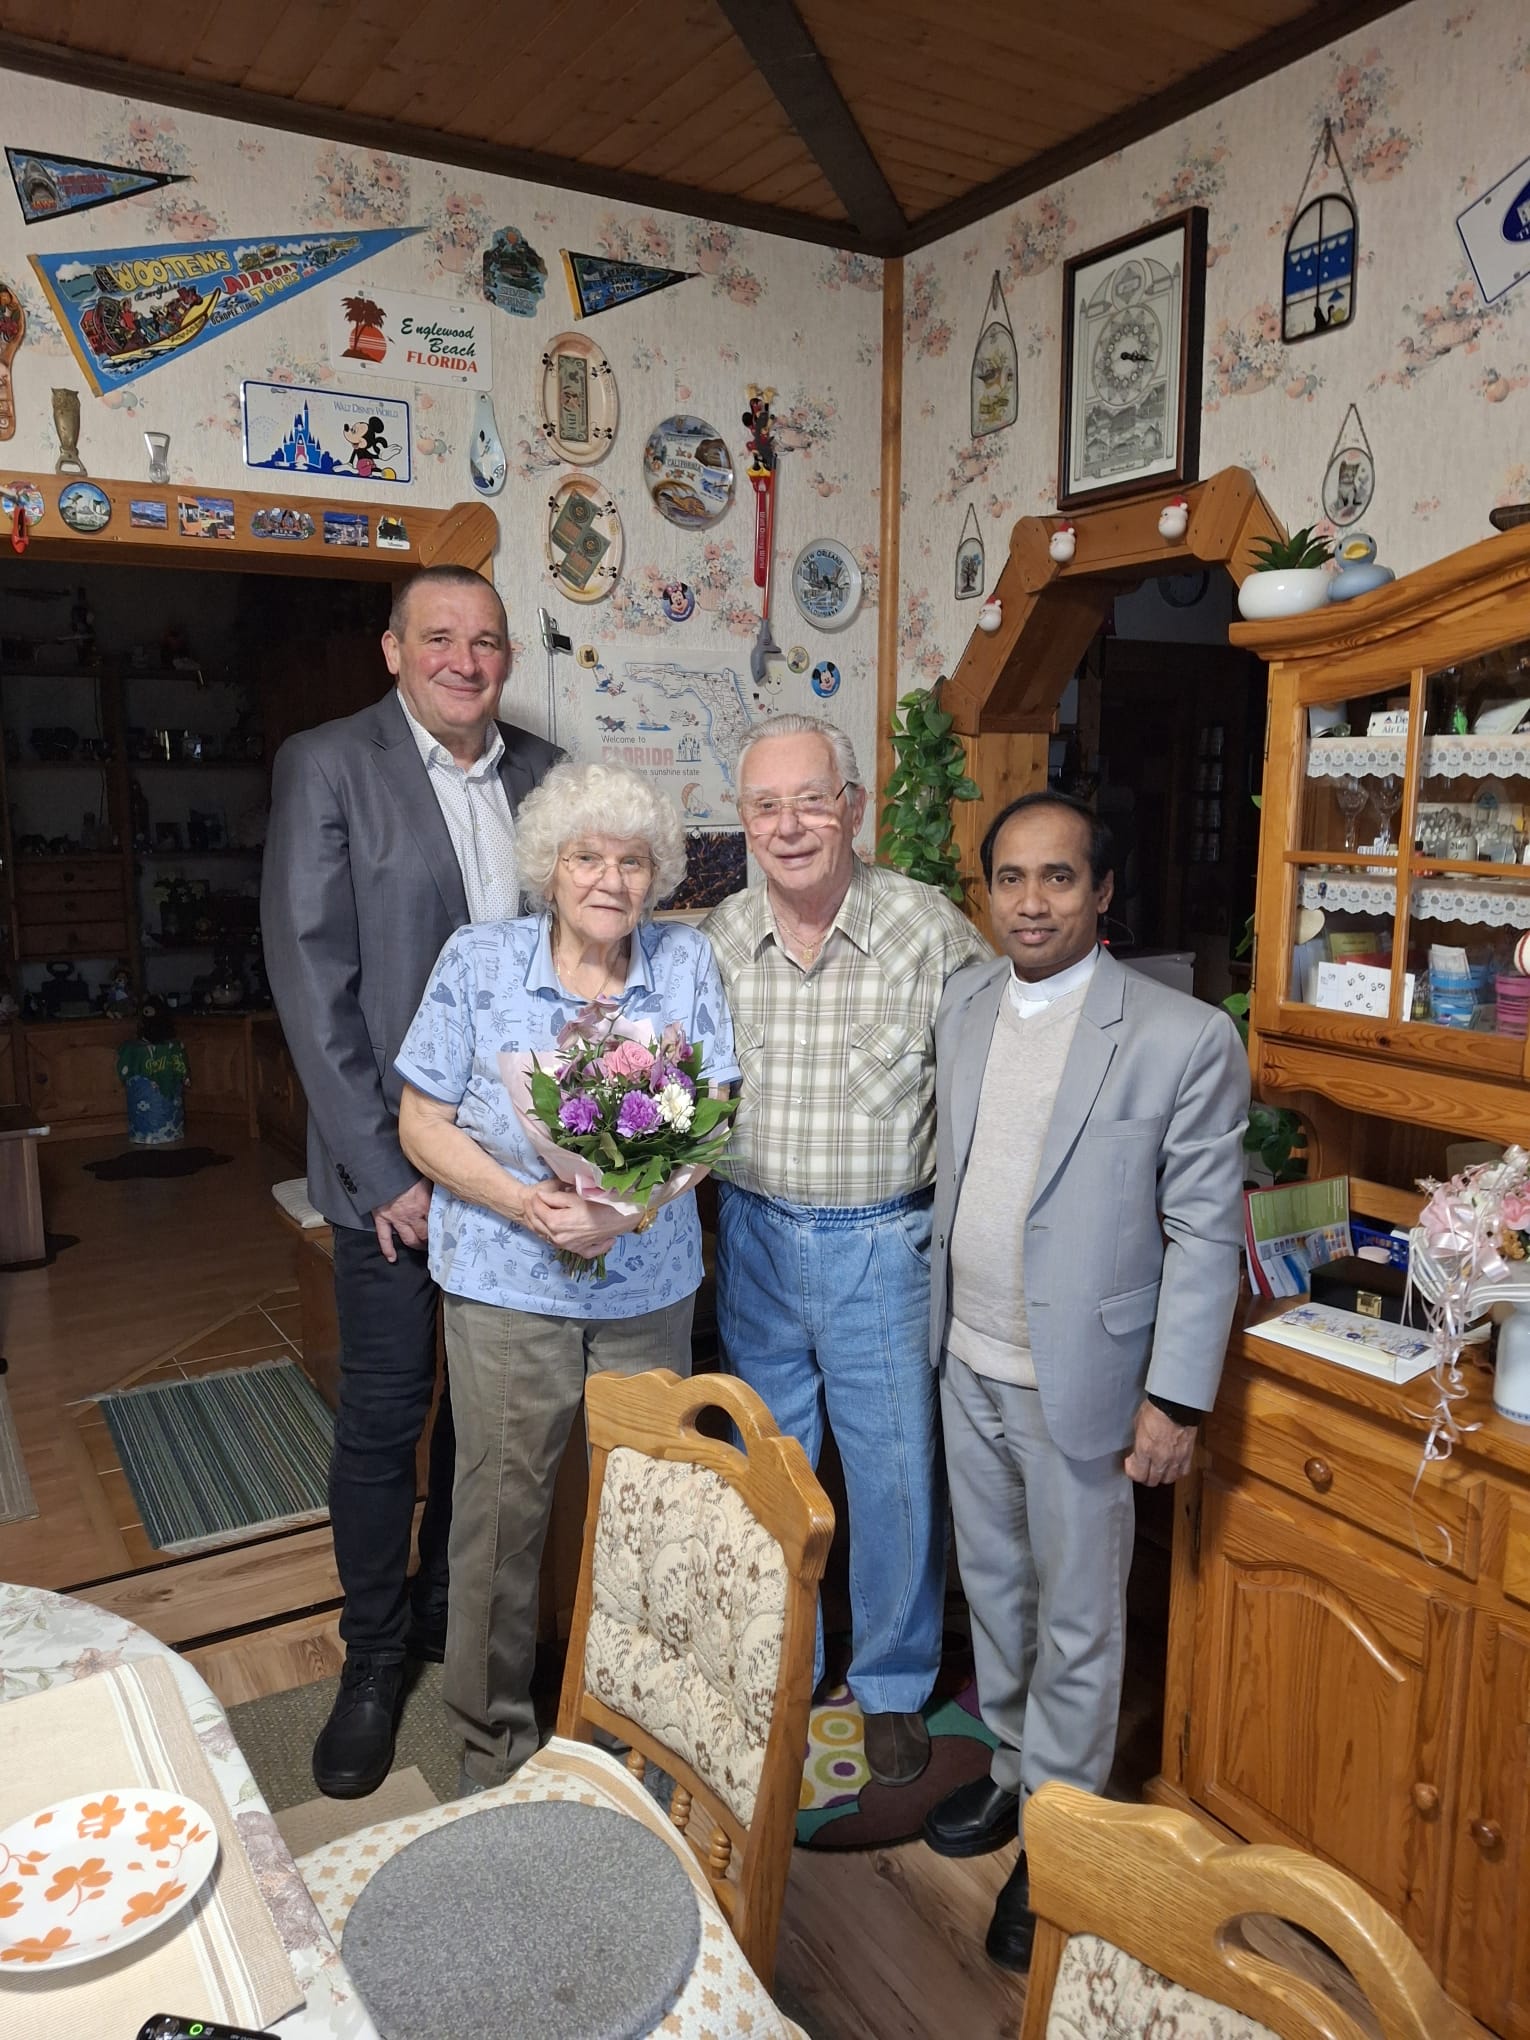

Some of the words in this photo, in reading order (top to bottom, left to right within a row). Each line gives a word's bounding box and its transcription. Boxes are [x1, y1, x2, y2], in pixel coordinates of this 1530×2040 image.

[106, 251, 231, 291] WOOTEN'S
[250, 271, 301, 303] TOURS
[429, 337, 476, 357] Beach
[407, 350, 478, 373] FLORIDA
[375, 406, 399, 418] WORLD
[803, 554, 815, 565] NEW
[601, 735, 636, 743] Welcome
[639, 735, 646, 743] to
[650, 768, 681, 776] sunshine
[682, 768, 700, 776] state
